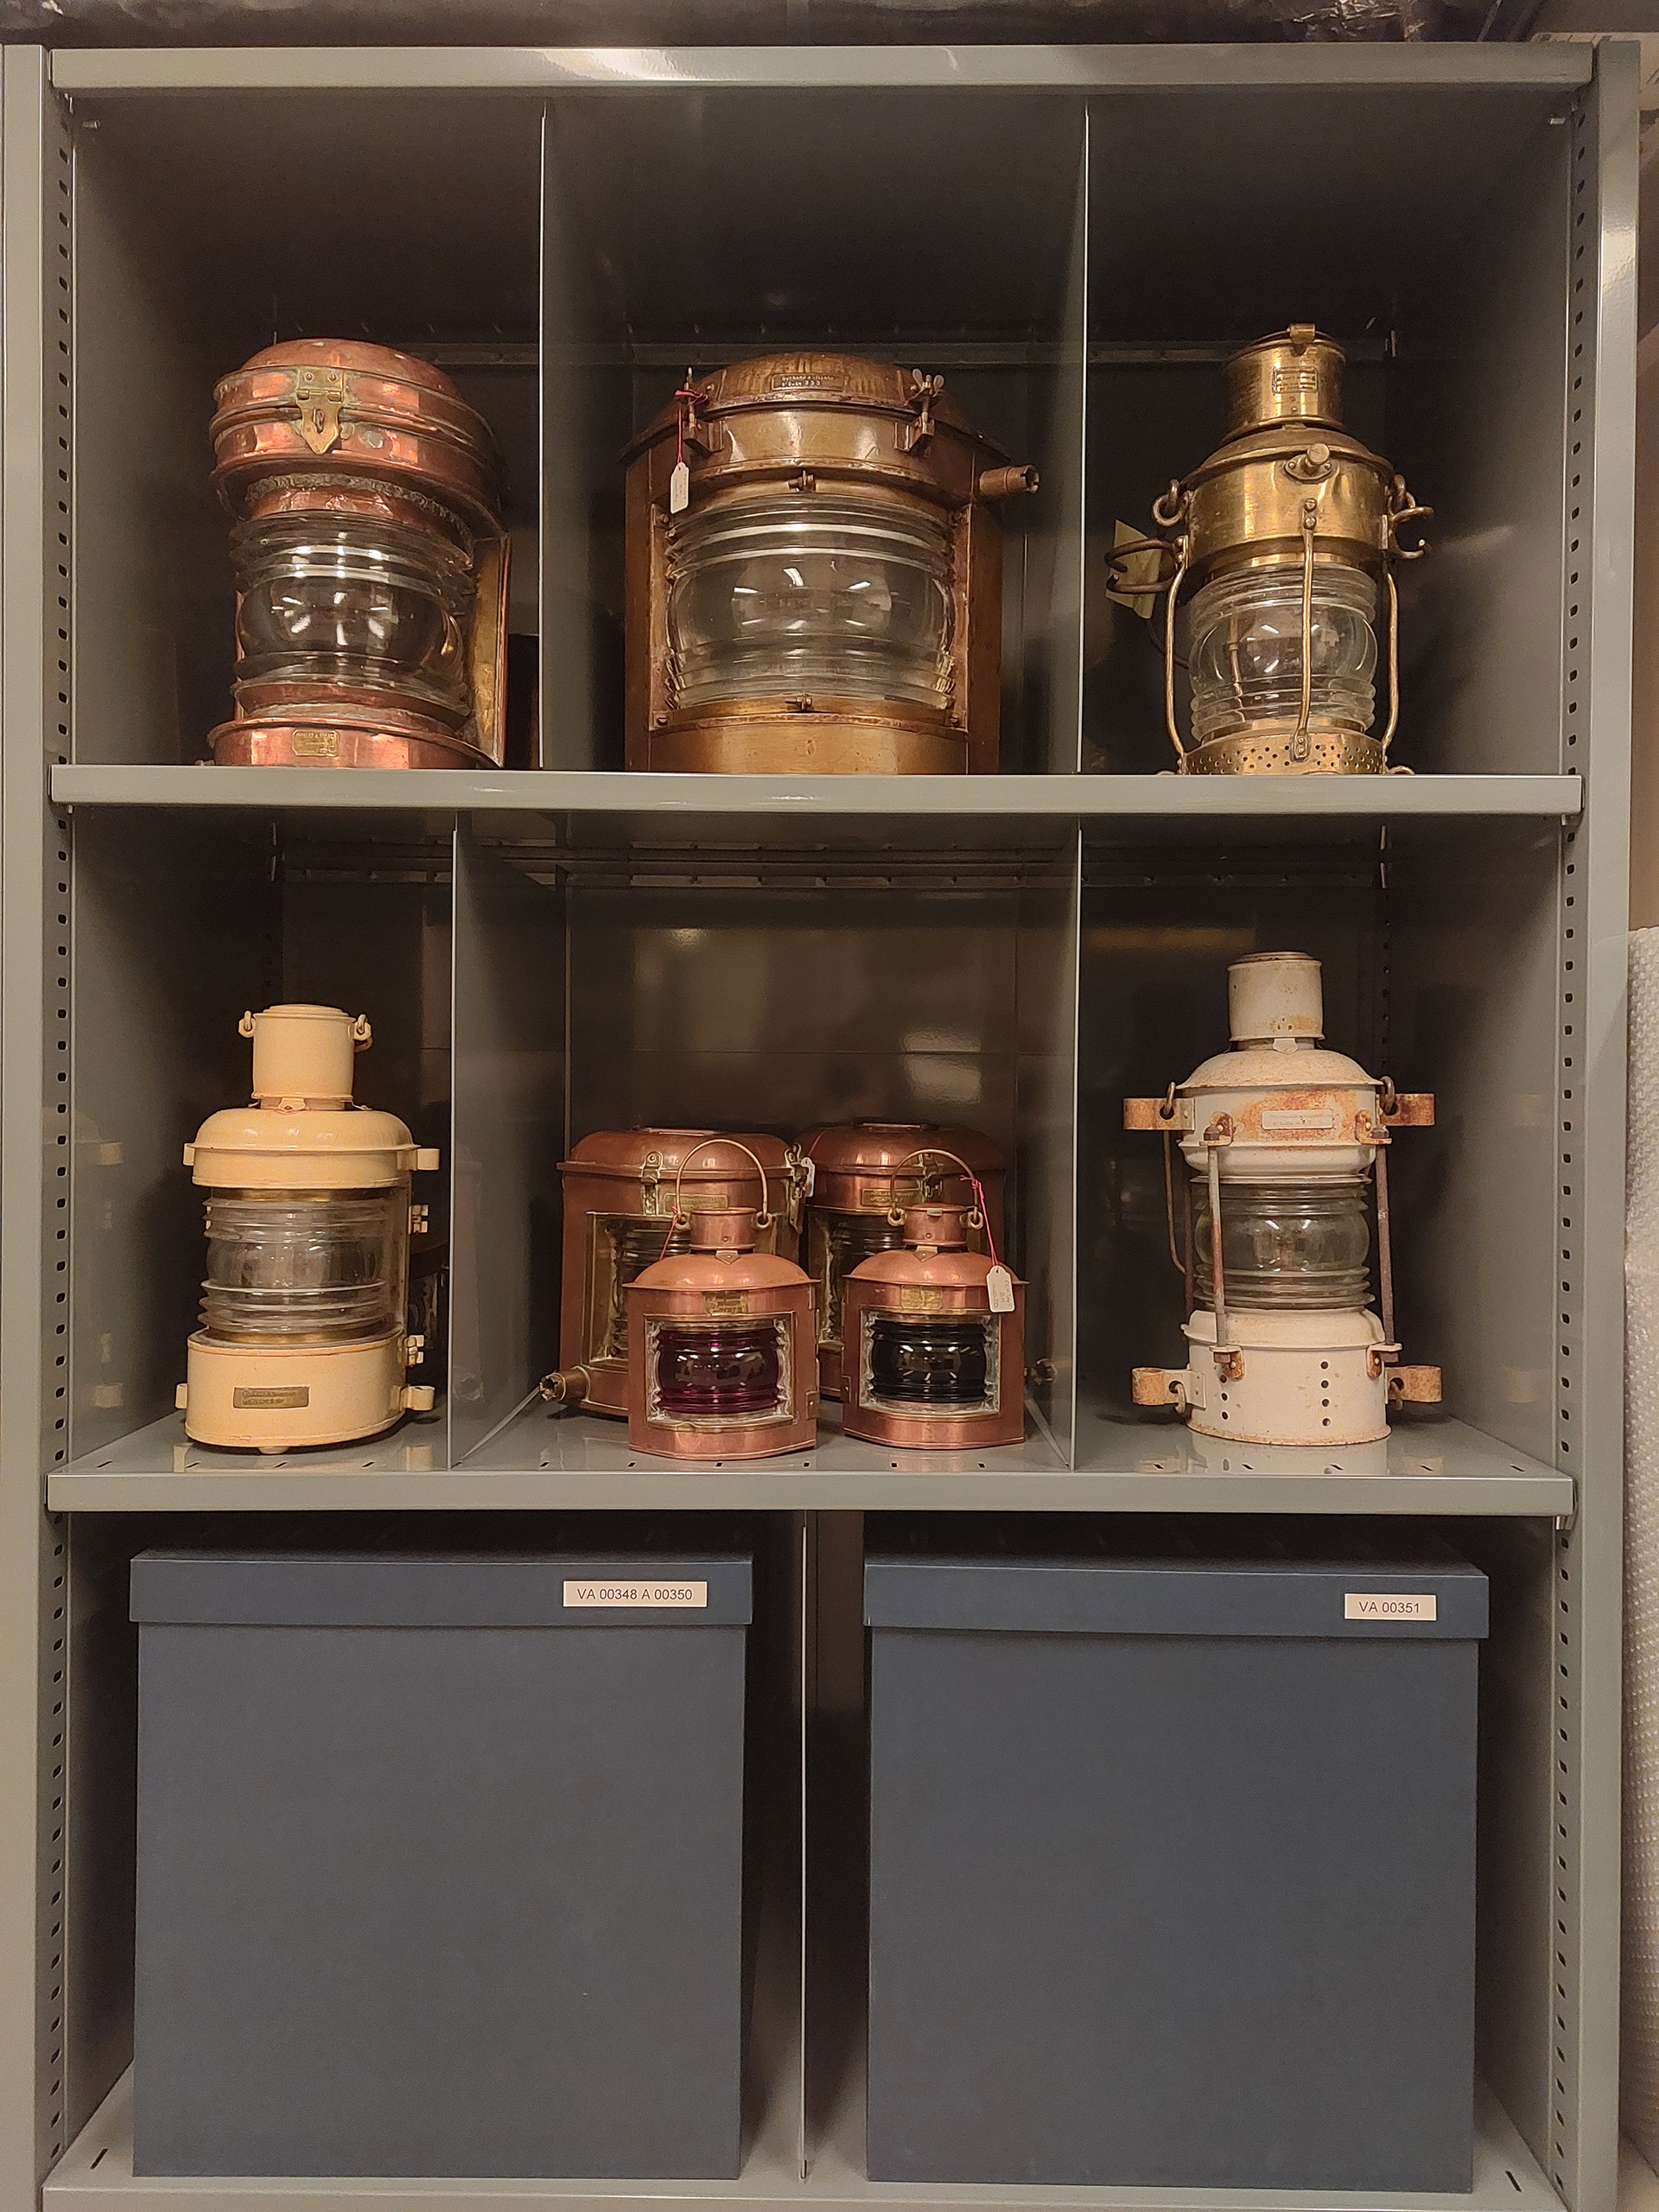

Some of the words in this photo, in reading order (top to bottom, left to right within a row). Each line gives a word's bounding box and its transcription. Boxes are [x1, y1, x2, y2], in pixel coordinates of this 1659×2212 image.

[576, 1588, 596, 1599] VA
[599, 1588, 638, 1600] 00348
[641, 1588, 651, 1599] A
[653, 1588, 693, 1600] 00350
[1358, 1601, 1379, 1612] VA
[1382, 1603, 1420, 1613] 00351
